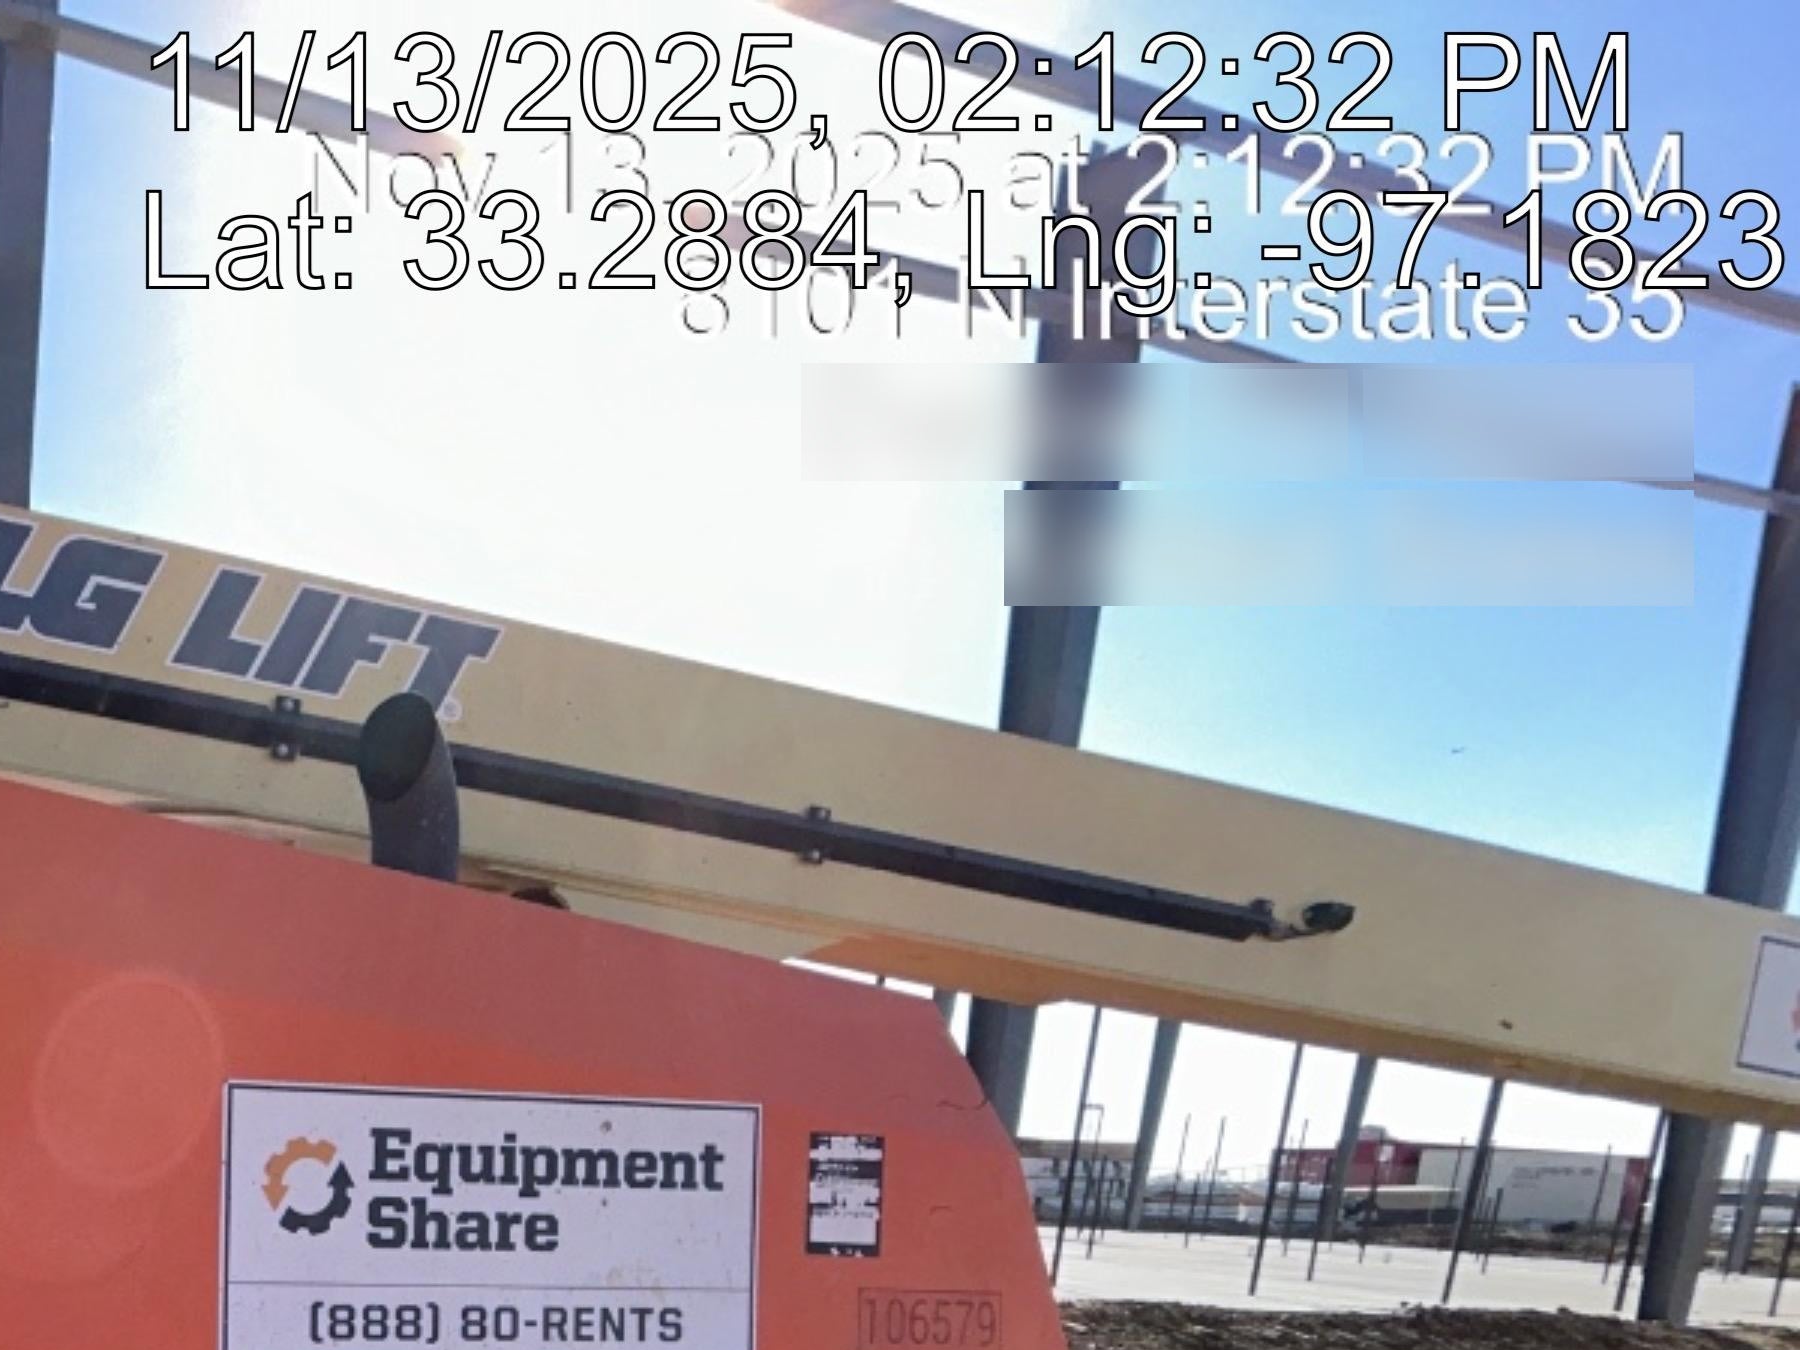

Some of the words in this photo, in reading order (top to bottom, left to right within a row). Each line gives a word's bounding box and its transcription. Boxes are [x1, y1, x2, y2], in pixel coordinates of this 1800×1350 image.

[165, 565, 505, 718] LIFT
[368, 1127, 725, 1198] Equipment
[366, 1196, 560, 1252] Share
[309, 1301, 441, 1344] (888)
[460, 1304, 684, 1343] 80-RENTS
[864, 1297, 997, 1348] 106579
